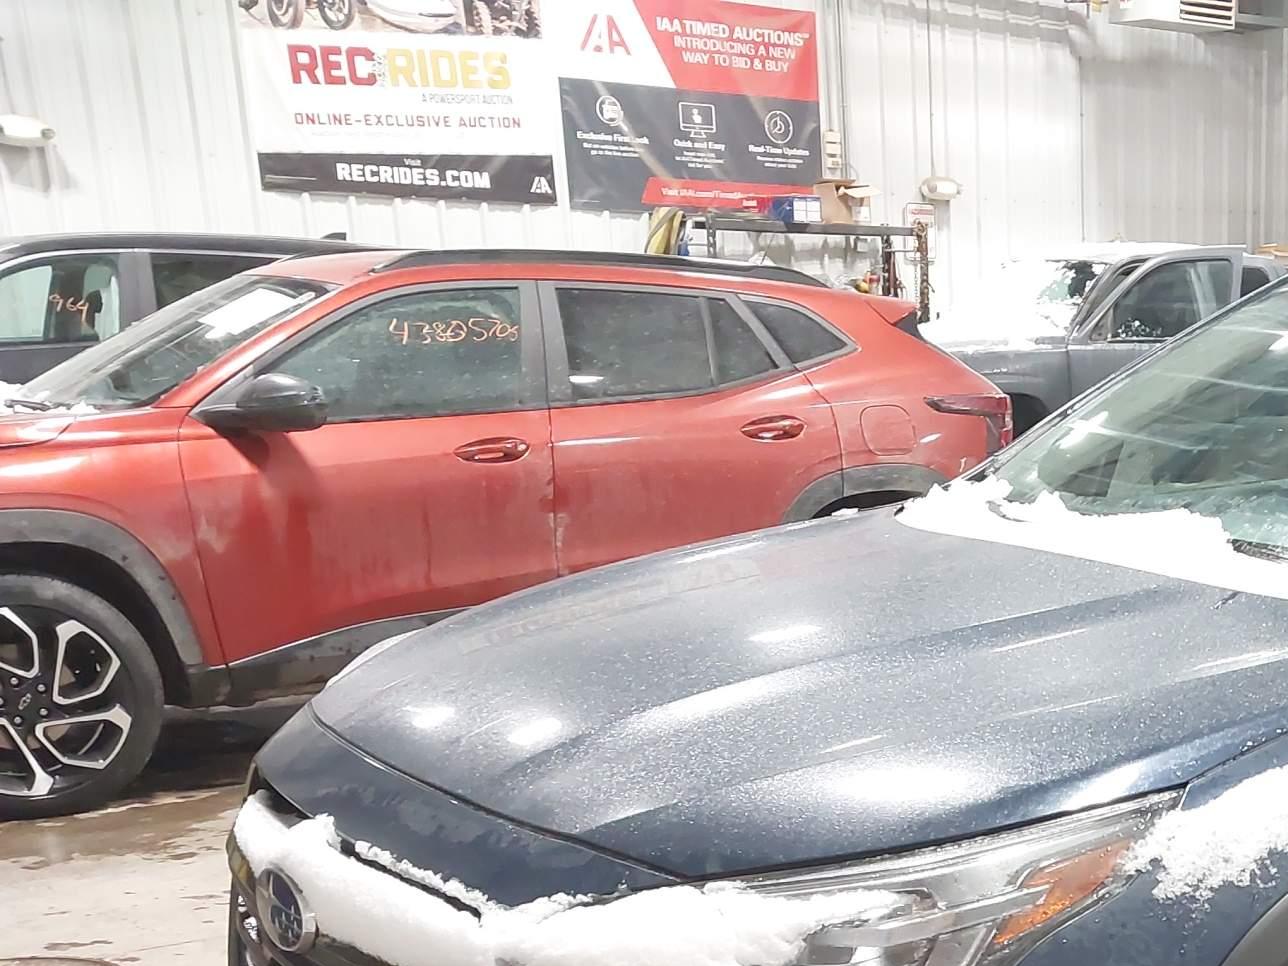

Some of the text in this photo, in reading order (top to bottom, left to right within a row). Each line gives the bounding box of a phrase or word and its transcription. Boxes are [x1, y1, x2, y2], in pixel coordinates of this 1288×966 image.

[656, 16, 682, 33] IAA
[682, 20, 730, 38] TIMED
[674, 35, 796, 60] INTRODUCING A NEW
[287, 44, 512, 90] REC RIDES
[682, 50, 789, 73] WAY TO BID & BUY
[294, 112, 521, 129] ONLINE-EXCLUSIVE AUCTION
[402, 156, 422, 167] Visit
[335, 162, 491, 189] RECRIDES.COM
